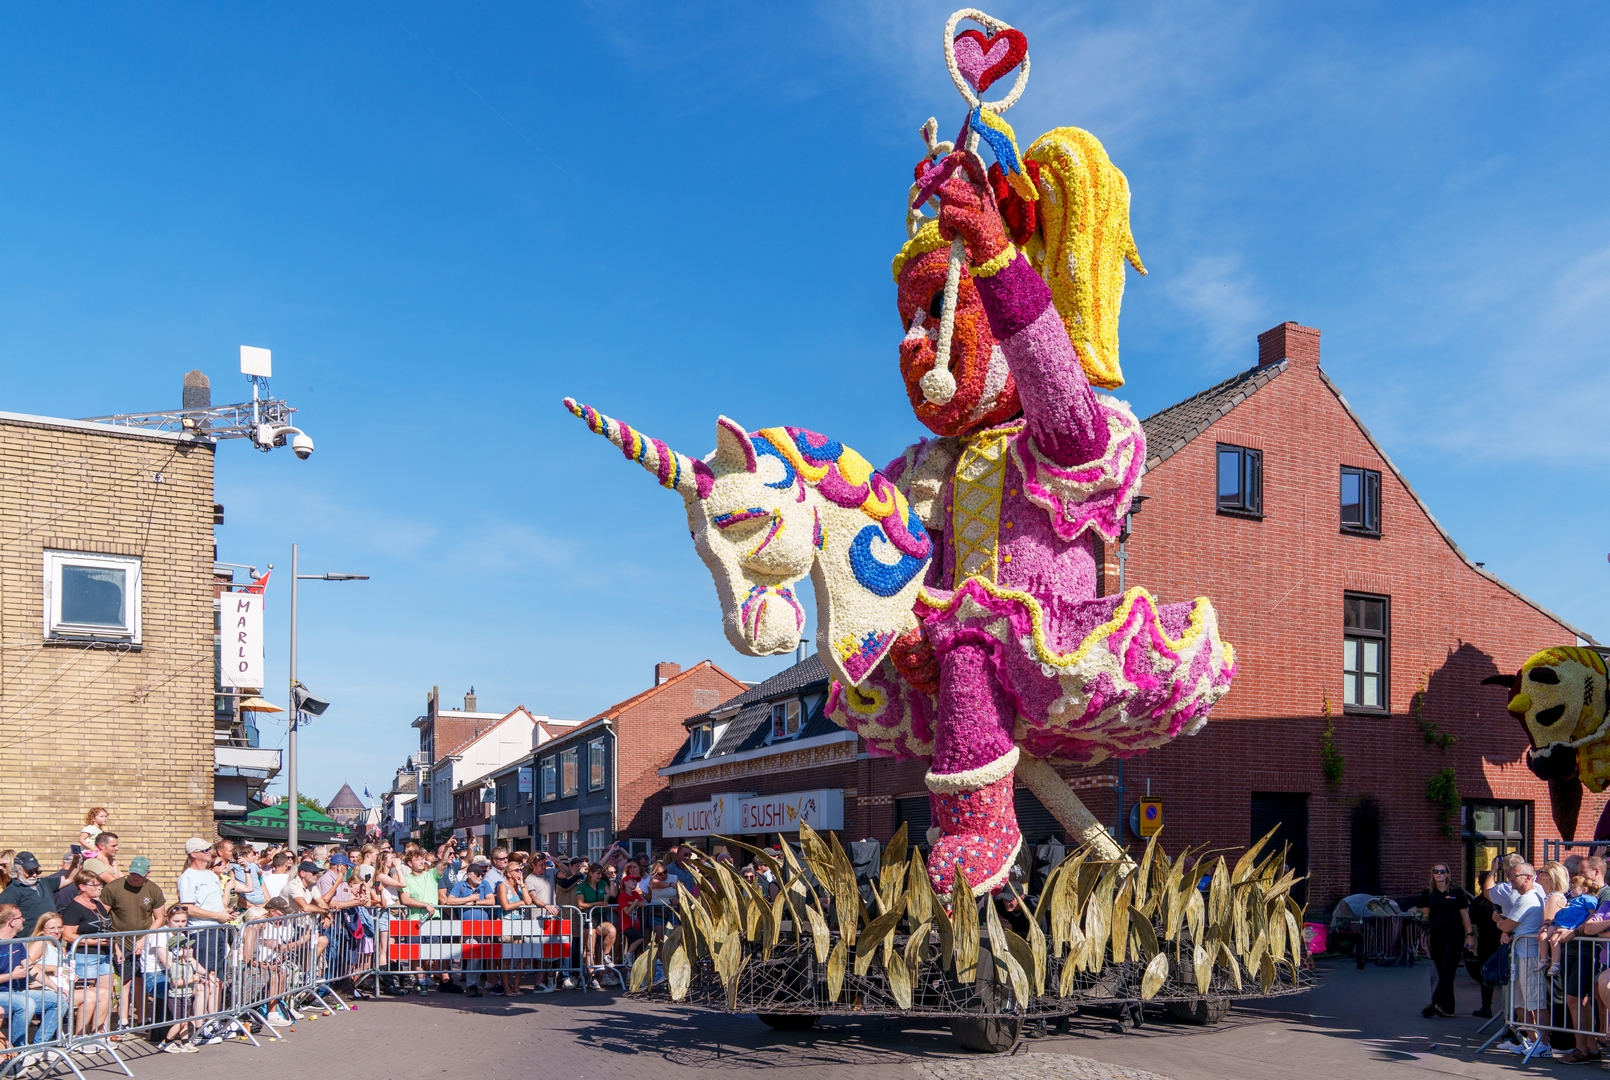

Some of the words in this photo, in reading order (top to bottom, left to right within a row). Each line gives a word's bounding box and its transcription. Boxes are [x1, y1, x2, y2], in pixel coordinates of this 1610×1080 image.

[237, 599, 250, 672] MARLO
[687, 809, 712, 831] LUCK
[751, 803, 784, 827] SUSHI
